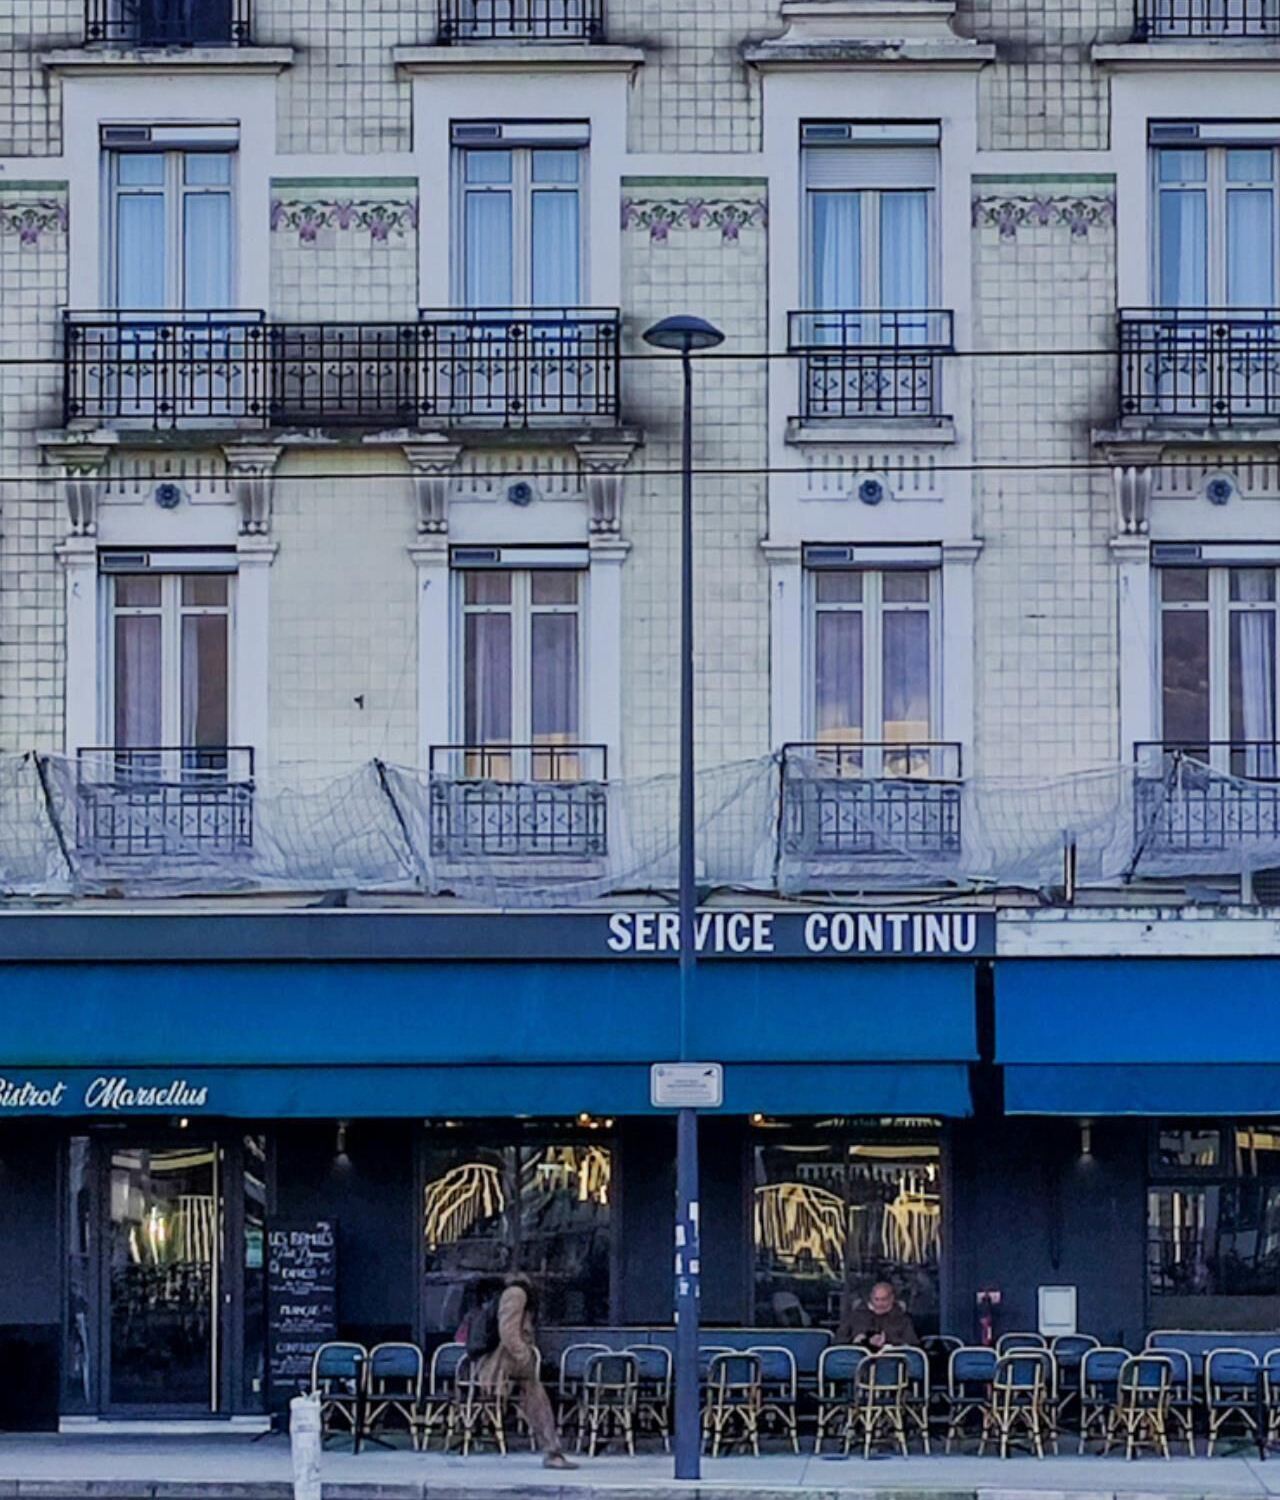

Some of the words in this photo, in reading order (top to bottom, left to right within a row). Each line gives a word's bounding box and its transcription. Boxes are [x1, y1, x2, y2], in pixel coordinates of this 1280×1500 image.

[607, 912, 774, 952] SERVICE
[804, 912, 976, 952] CONTINU
[85, 1077, 208, 1110] Marsellus
